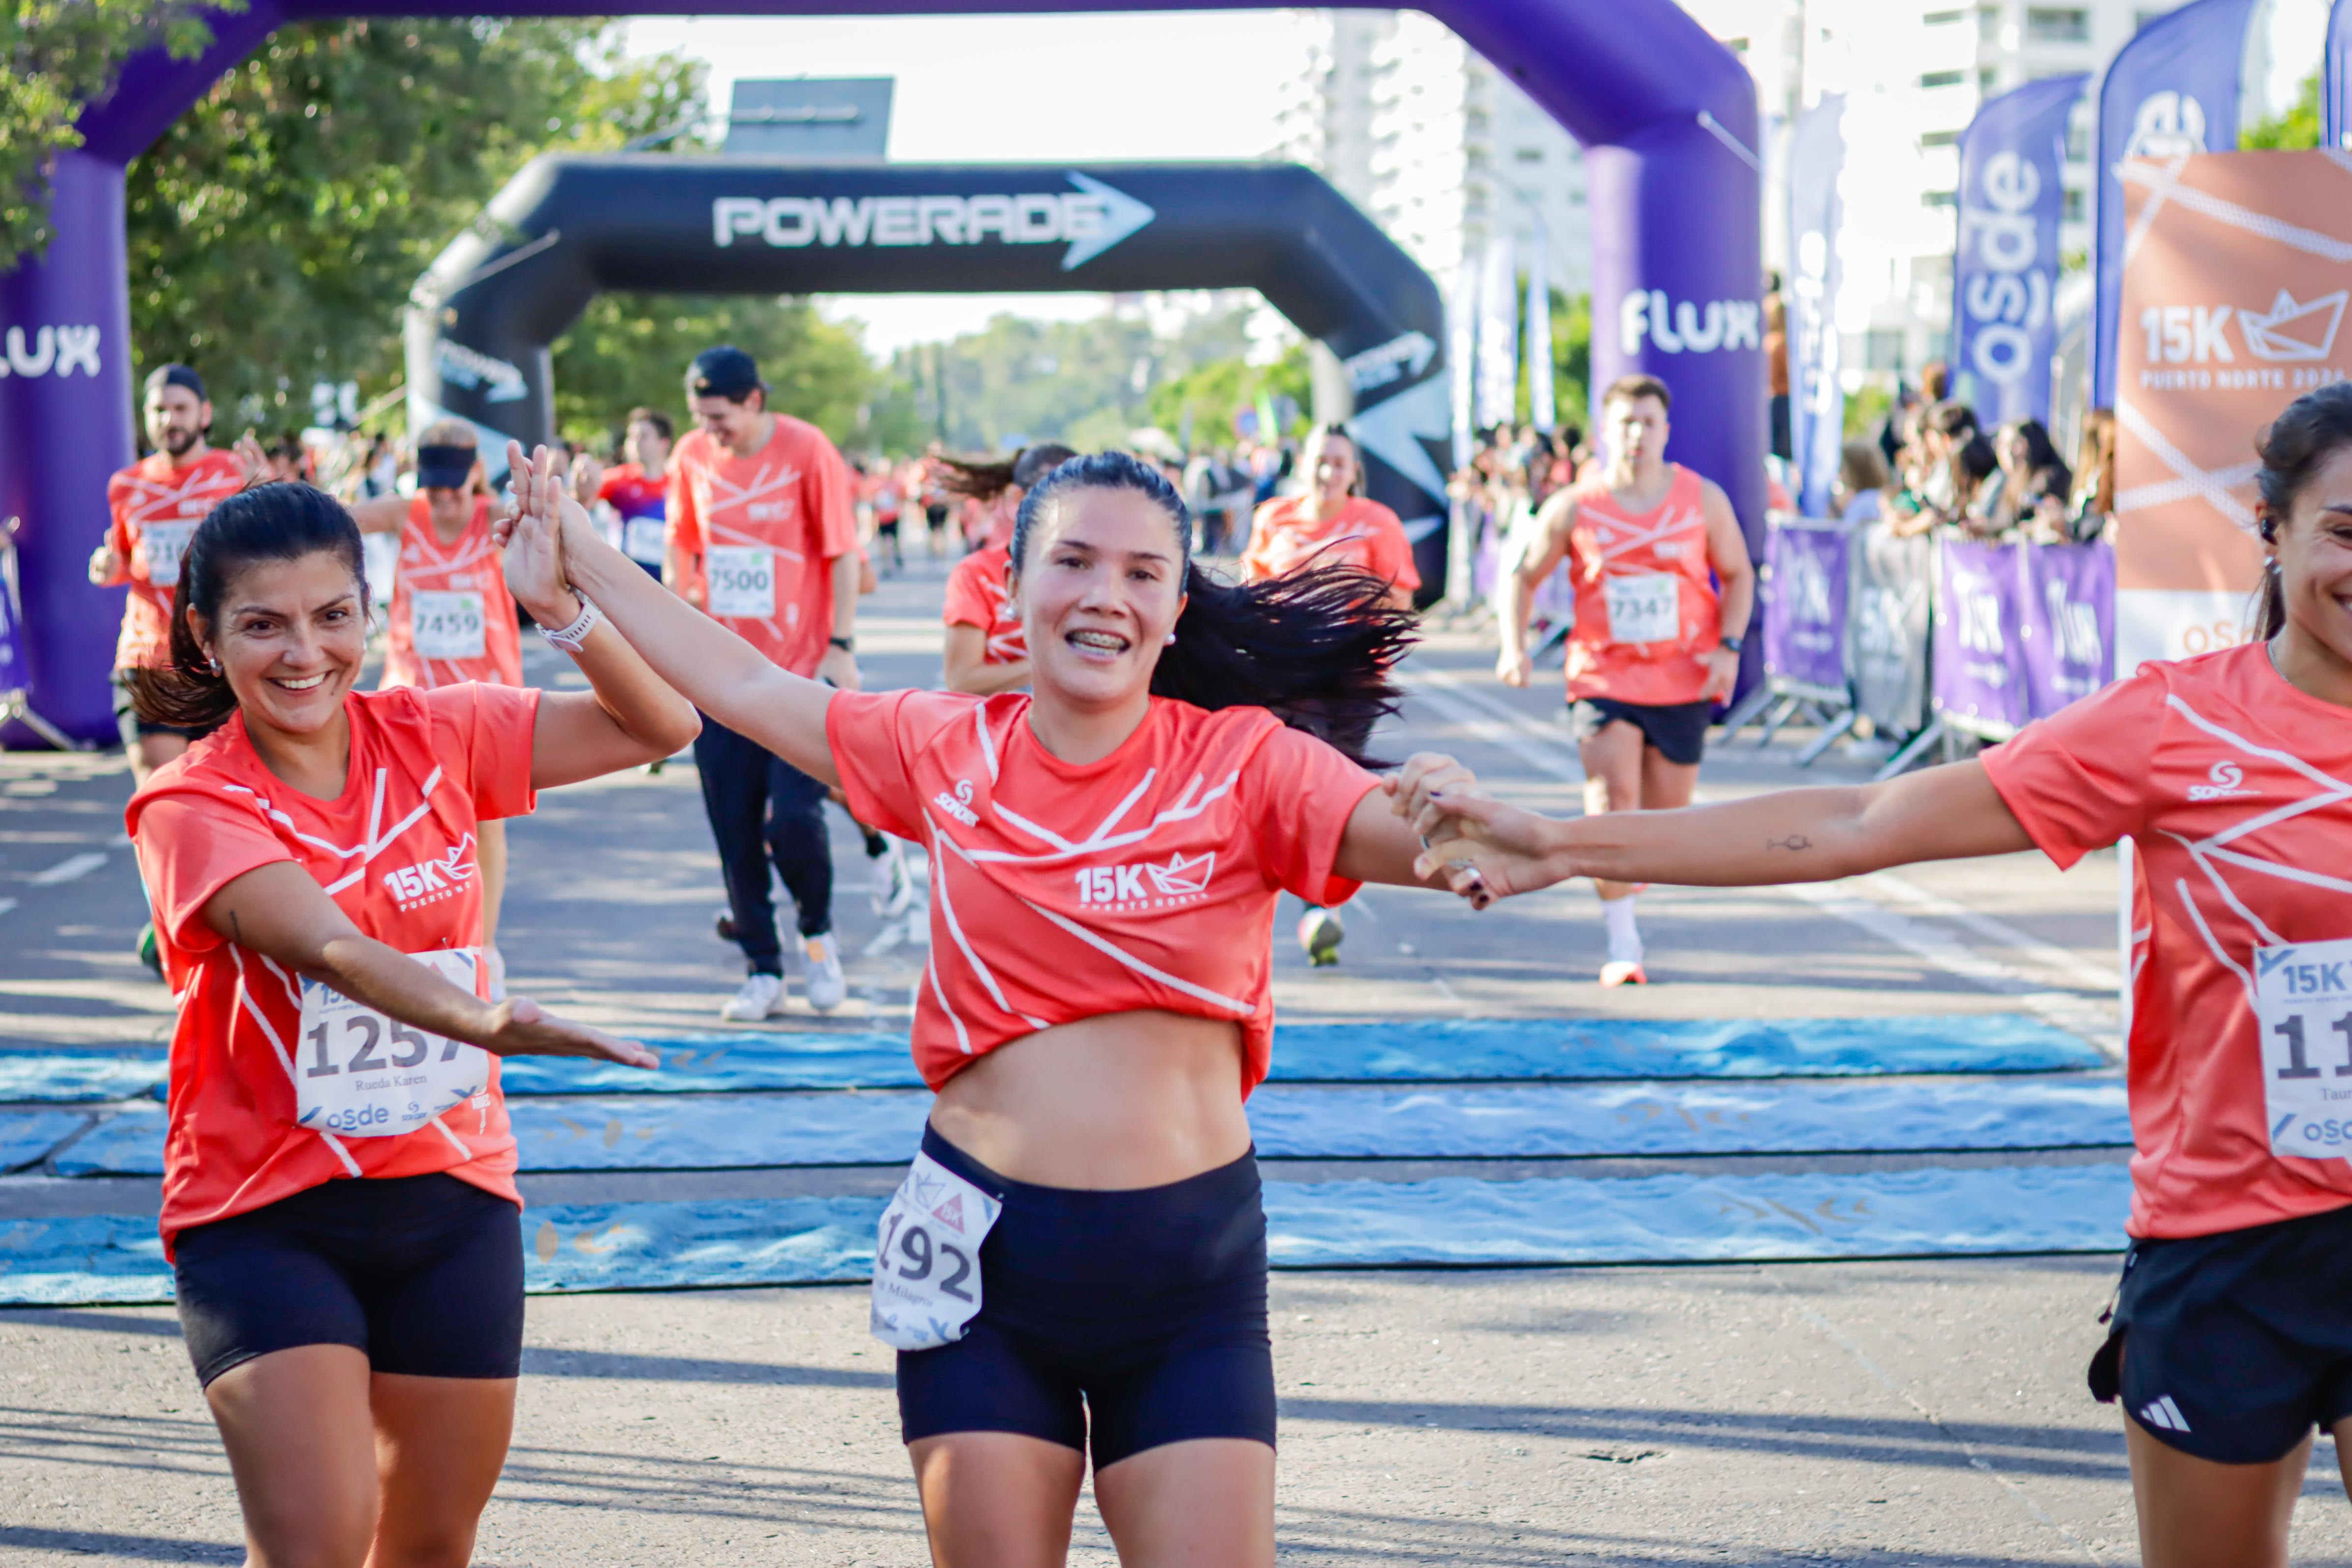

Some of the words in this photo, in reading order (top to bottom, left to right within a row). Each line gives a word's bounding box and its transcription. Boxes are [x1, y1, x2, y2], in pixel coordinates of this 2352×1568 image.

[712, 194, 1109, 247] POWERADE
[1966, 150, 2049, 384] osde
[1620, 288, 1761, 356] FLUX
[2140, 304, 2235, 364] 15K
[2141, 369, 2211, 390] PUERTO
[2217, 368, 2286, 389] NORTE
[710, 569, 768, 591] 7500
[383, 860, 448, 901] 15K
[1075, 864, 1147, 903] 15K
[400, 889, 452, 912] PUERTO
[2282, 962, 2348, 994] 15K
[321, 984, 350, 1005] 15
[355, 1079, 391, 1091] Rueda
[394, 1075, 427, 1087] Karen
[326, 1104, 389, 1130] osde
